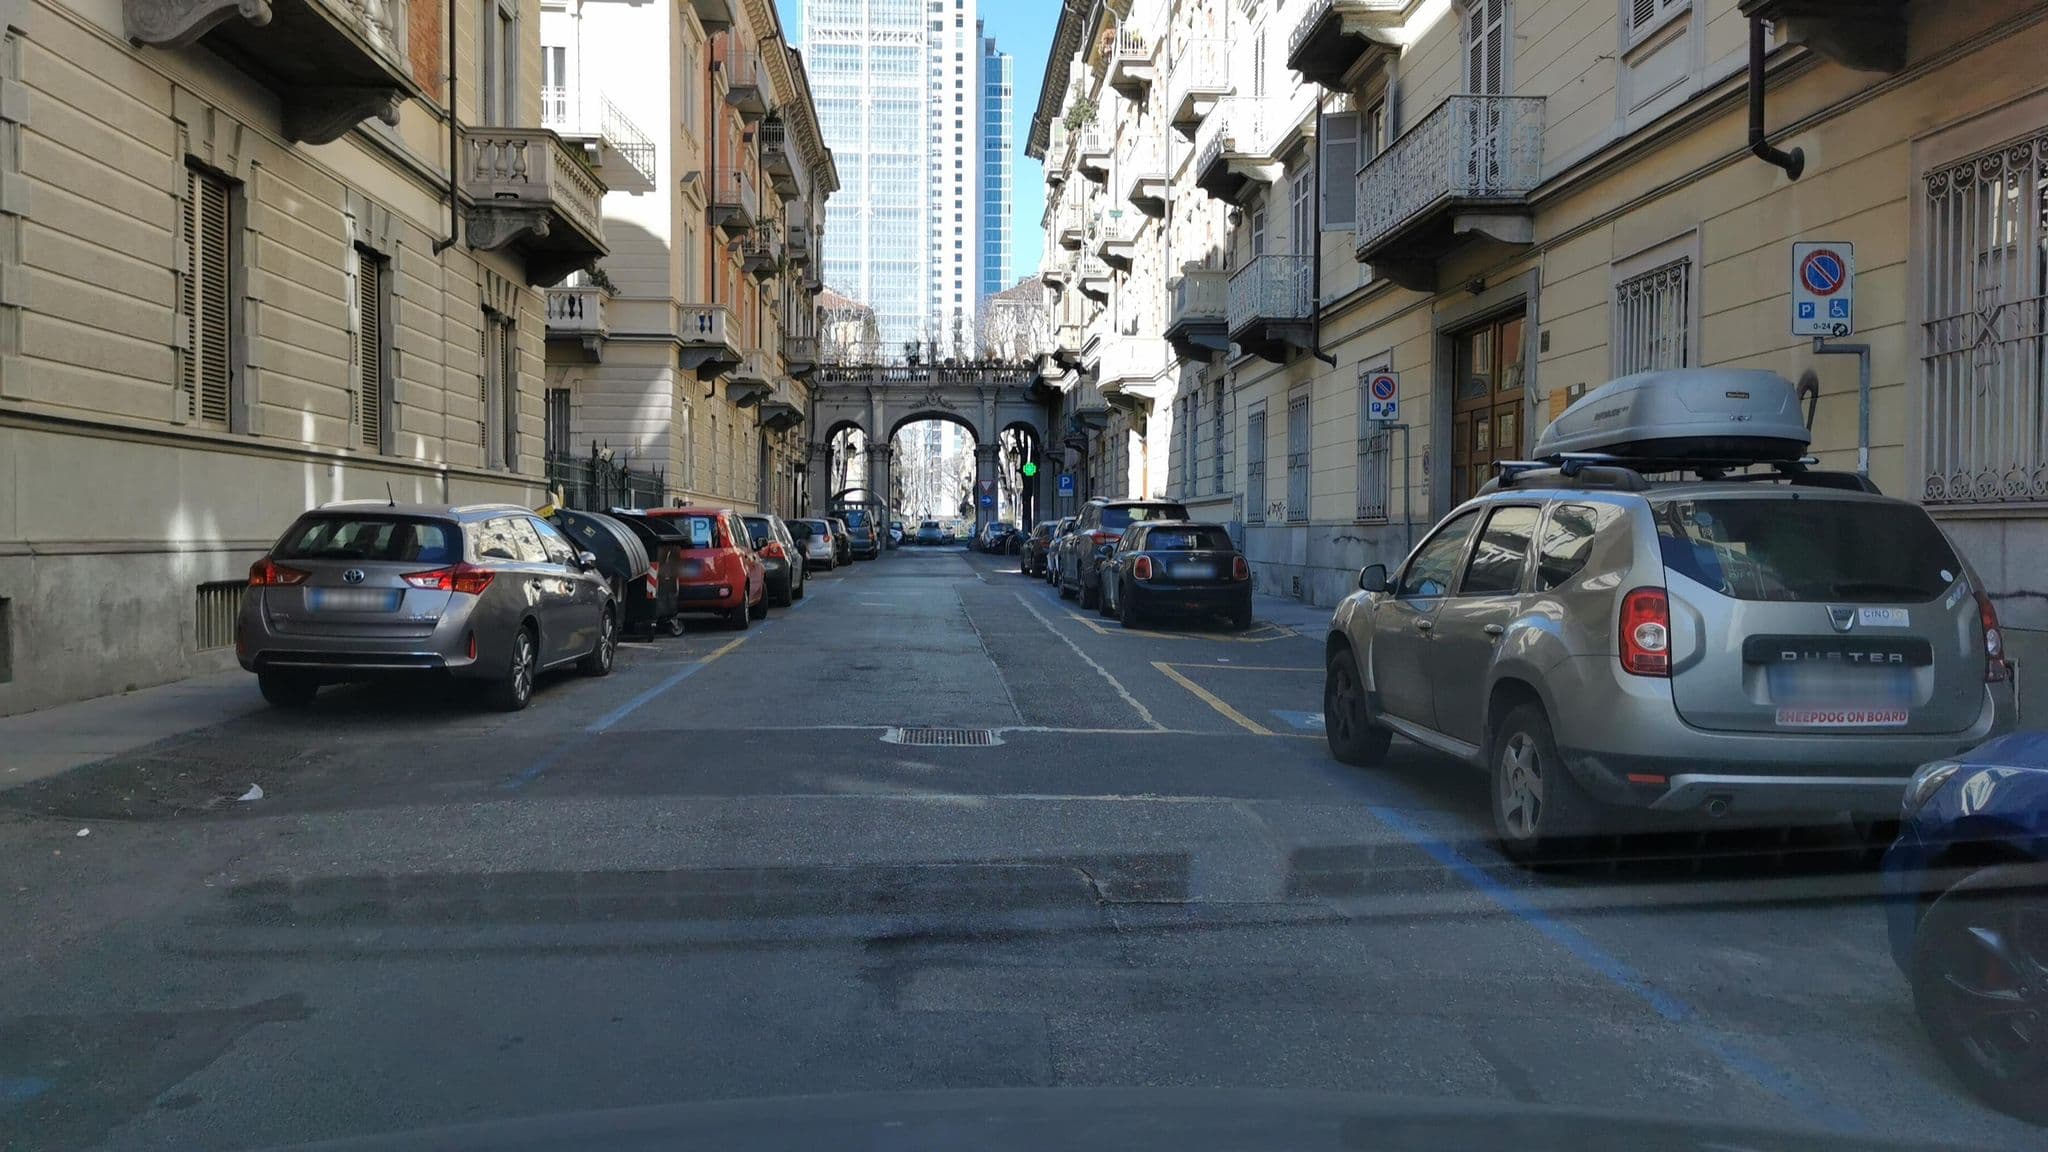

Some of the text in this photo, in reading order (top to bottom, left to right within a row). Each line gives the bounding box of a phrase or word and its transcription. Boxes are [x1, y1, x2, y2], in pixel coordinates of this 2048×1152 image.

[1802, 305, 1811, 317] P
[1813, 322, 1831, 330] 0-24
[1374, 403, 1380, 411] P
[1061, 476, 1070, 488] P
[694, 520, 708, 537] P
[1781, 651, 1903, 663] DUSTER
[1778, 711, 1907, 722] SHEEPDOG ON BOARD
